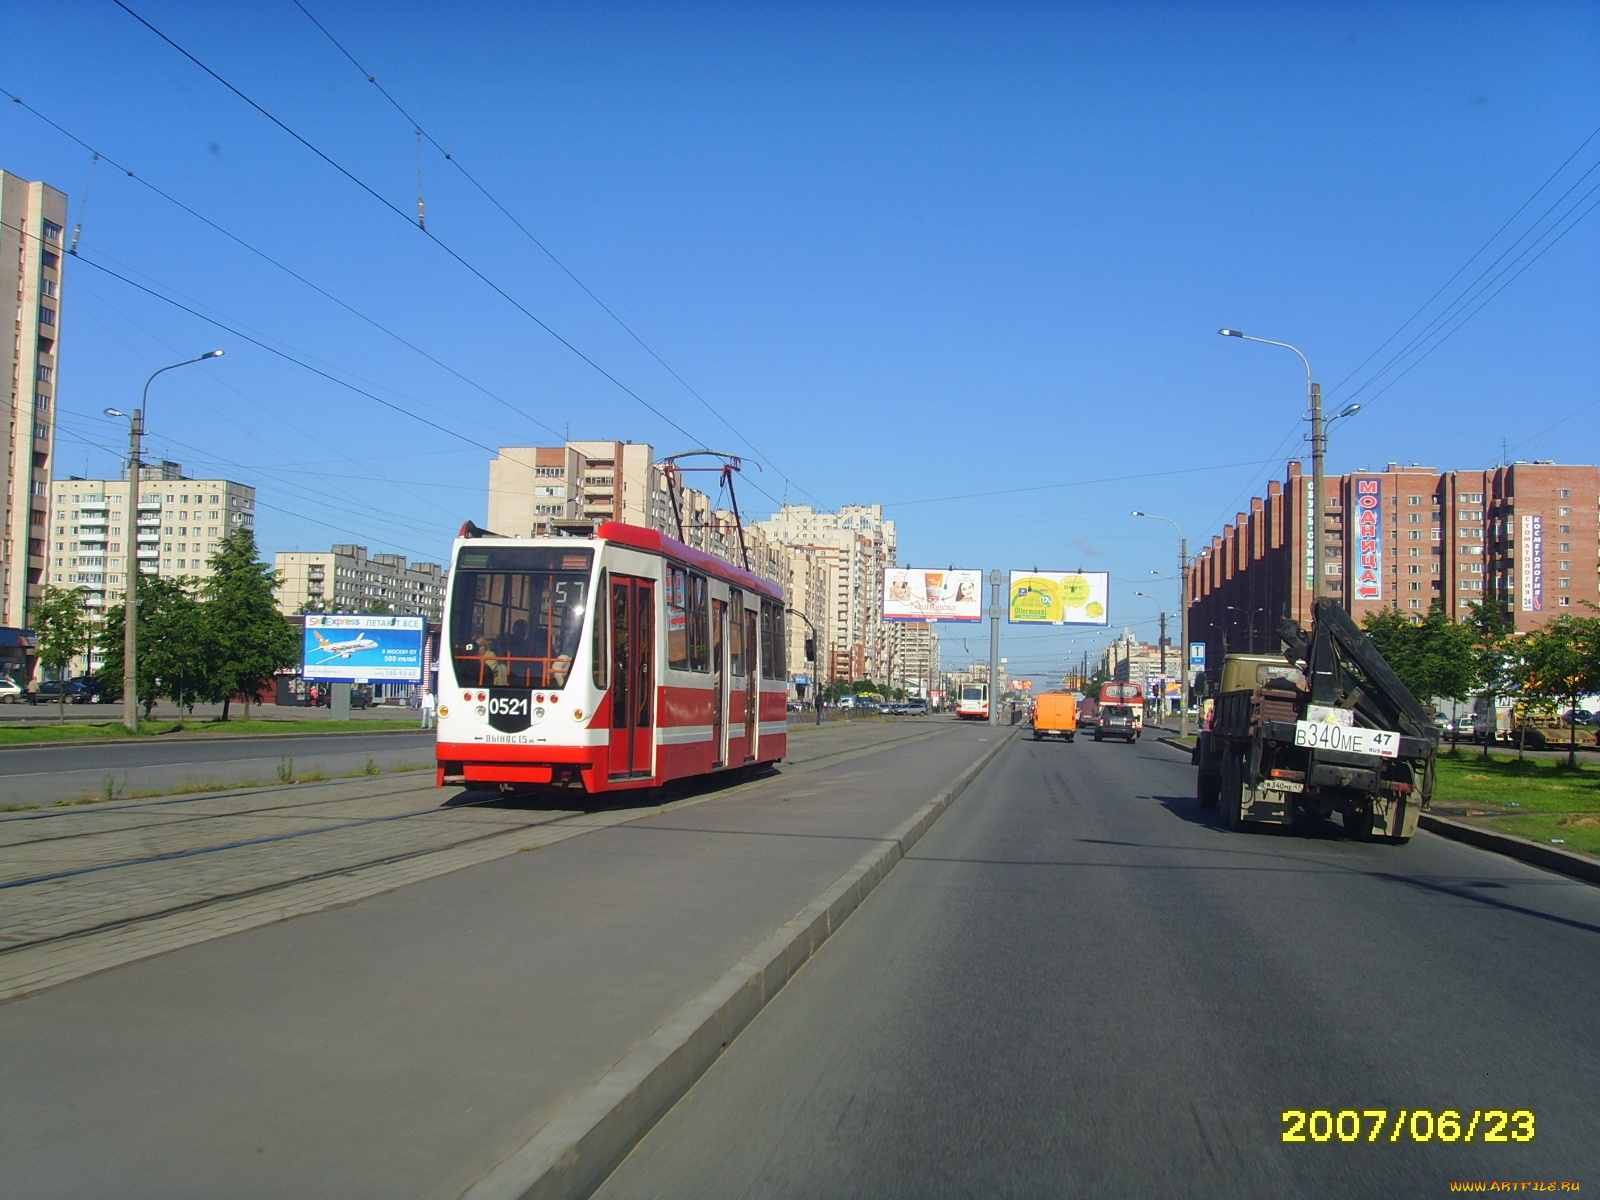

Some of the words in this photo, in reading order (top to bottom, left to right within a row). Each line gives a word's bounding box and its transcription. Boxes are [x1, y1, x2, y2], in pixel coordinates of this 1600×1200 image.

[1358, 480, 1378, 582] МОДНИЦА
[1523, 516, 1531, 595] СТОМАТОЛОГИЯ
[1533, 517, 1541, 596] КОСМЕТОЛОГИЯ
[555, 581, 585, 603] 57
[403, 620, 418, 628] ВСЕ
[489, 698, 528, 715] 0521
[486, 734, 517, 744] ВЫНОС
[1373, 733, 1392, 746] 47
